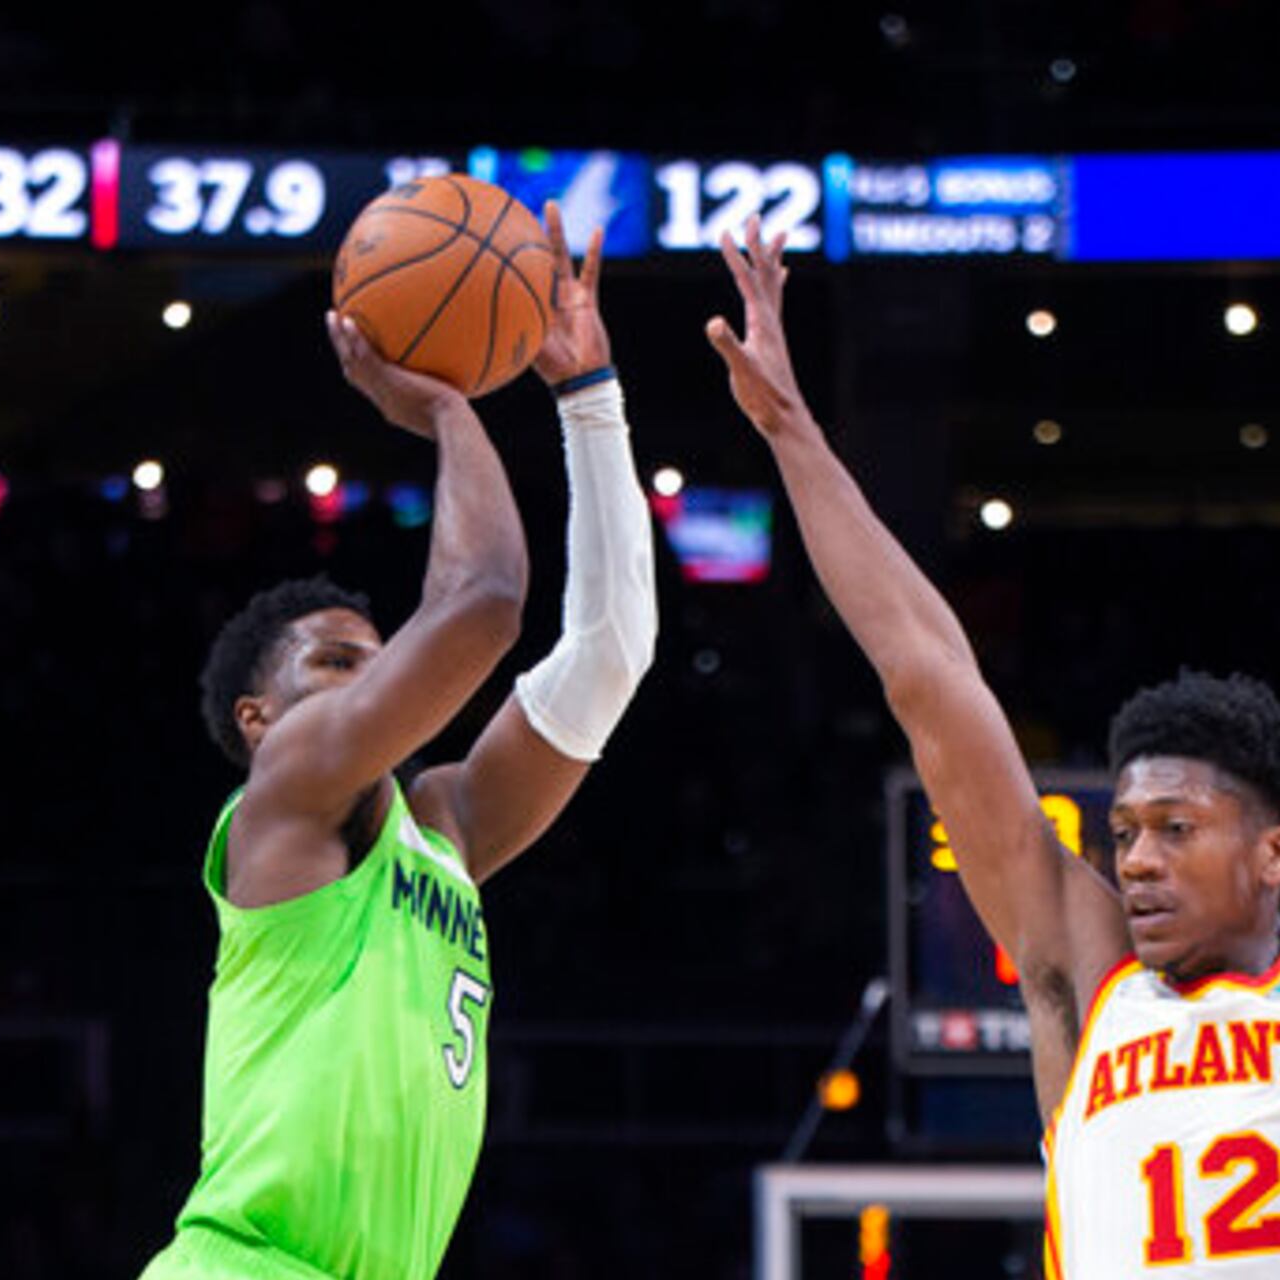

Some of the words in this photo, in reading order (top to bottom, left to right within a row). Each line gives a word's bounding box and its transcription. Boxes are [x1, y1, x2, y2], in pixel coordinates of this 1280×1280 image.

[146, 158, 327, 238] 37.9
[654, 159, 821, 252] 122
[391, 857, 484, 962] MINNE
[442, 966, 492, 1090] 5
